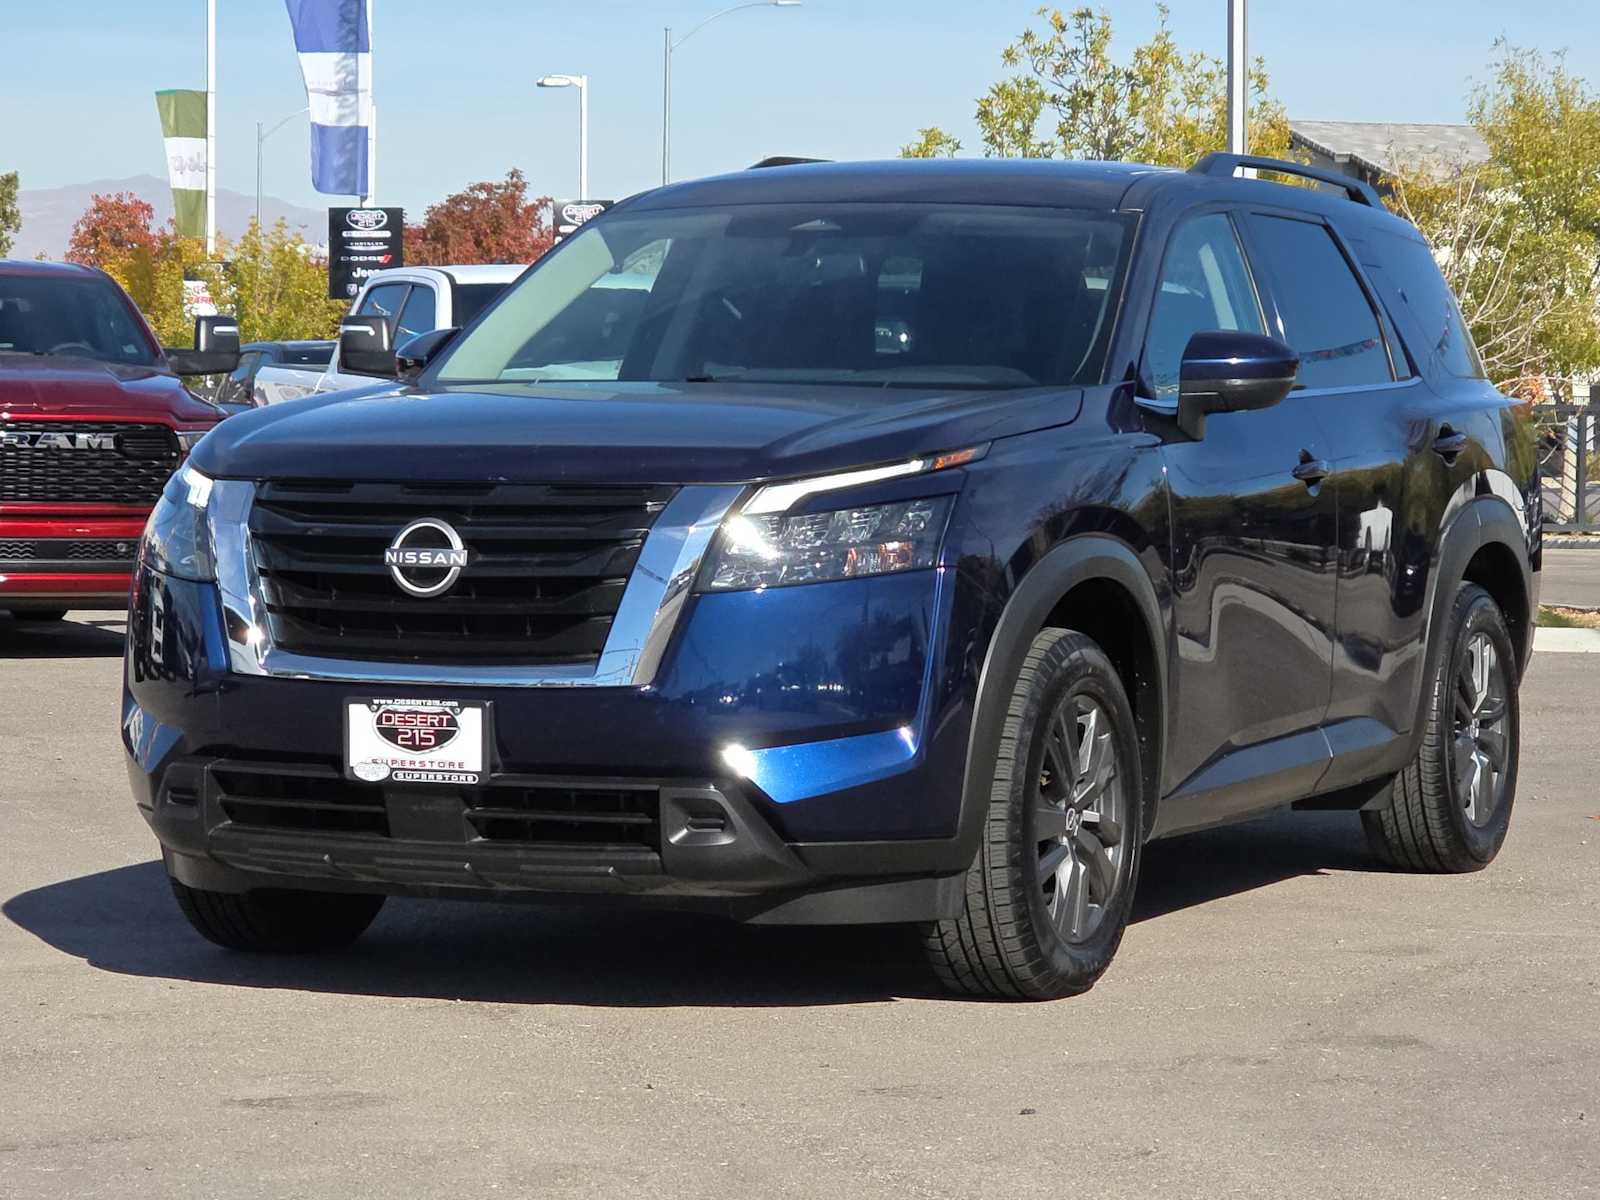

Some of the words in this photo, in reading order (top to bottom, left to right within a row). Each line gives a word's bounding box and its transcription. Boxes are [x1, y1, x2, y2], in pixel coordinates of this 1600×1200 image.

[0, 431, 116, 449] RAM
[385, 551, 465, 564] NISSAN
[381, 713, 452, 727] DESERT
[397, 728, 436, 746] 215
[397, 773, 475, 783] SUPERSTORE
